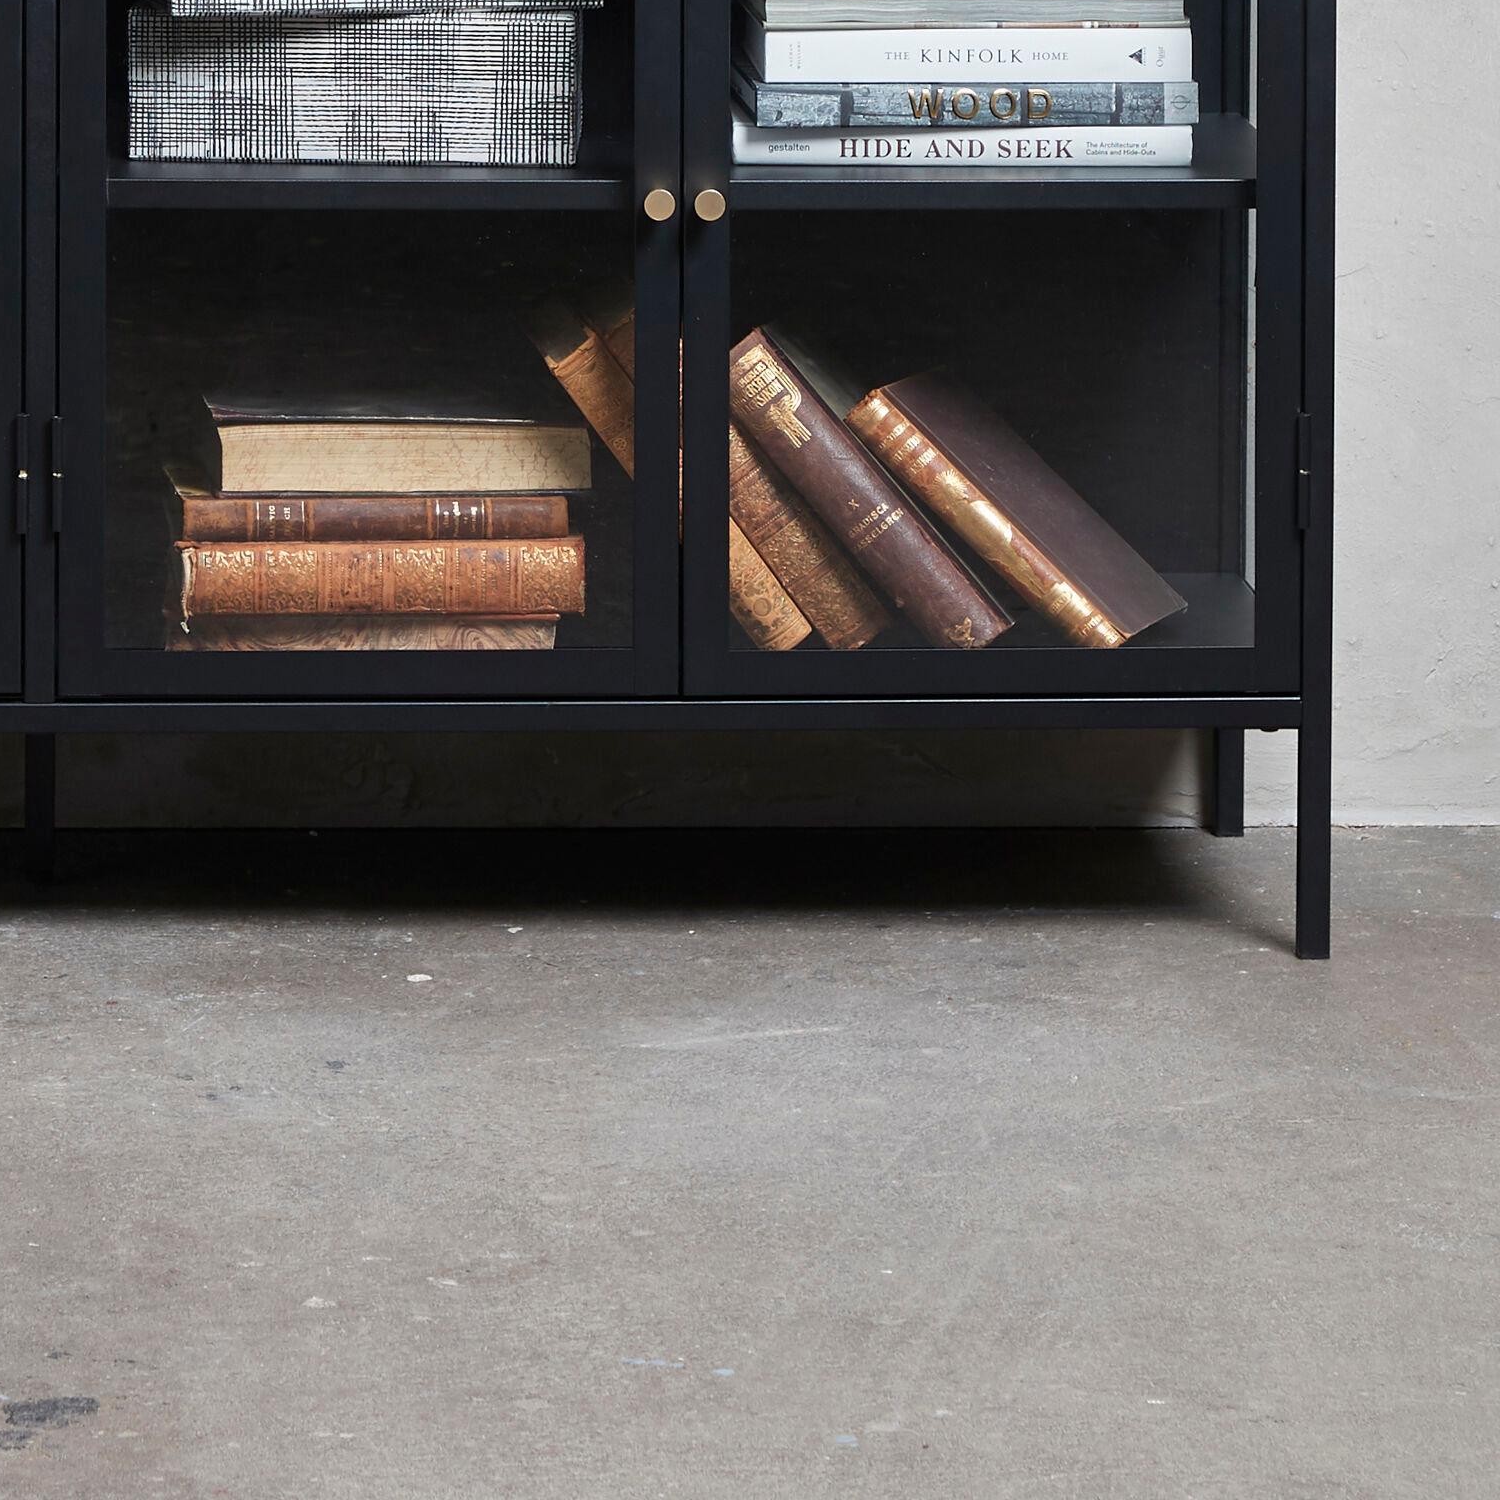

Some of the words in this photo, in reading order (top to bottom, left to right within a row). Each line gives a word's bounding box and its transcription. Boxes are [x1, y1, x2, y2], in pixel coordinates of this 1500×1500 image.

[884, 51, 910, 60] THE
[920, 49, 1024, 63] KINFOLK
[1032, 52, 1069, 61] HOME
[907, 87, 1053, 120] WOOD
[768, 142, 810, 154] gestalten
[839, 138, 912, 158] HIDE
[924, 138, 985, 158] AND
[997, 138, 1074, 159] SEEK
[848, 498, 860, 511] X
